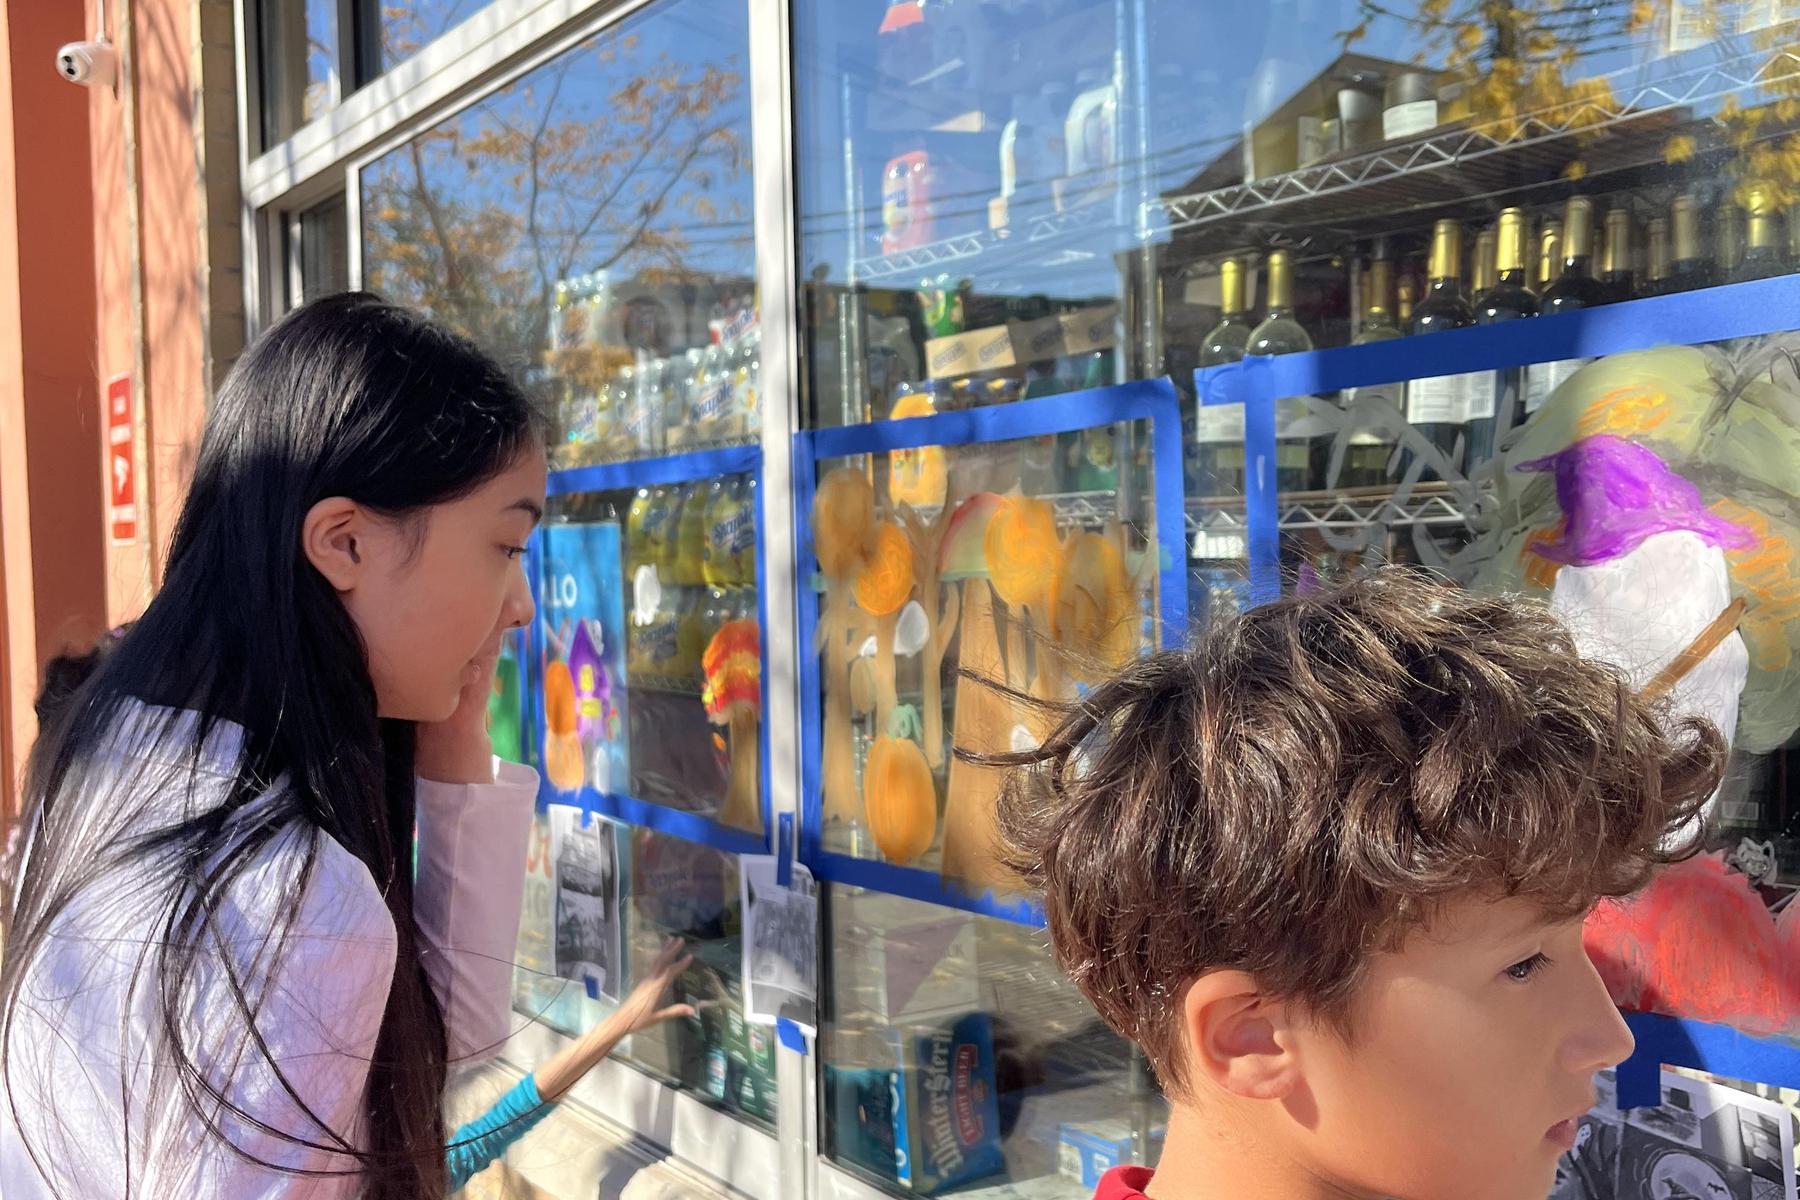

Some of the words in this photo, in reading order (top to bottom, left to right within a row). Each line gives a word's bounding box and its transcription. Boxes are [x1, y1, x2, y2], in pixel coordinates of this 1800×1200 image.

[690, 380, 734, 424] Snapple
[957, 1050, 970, 1089] BEER
[958, 1095, 975, 1137] LIGHT
